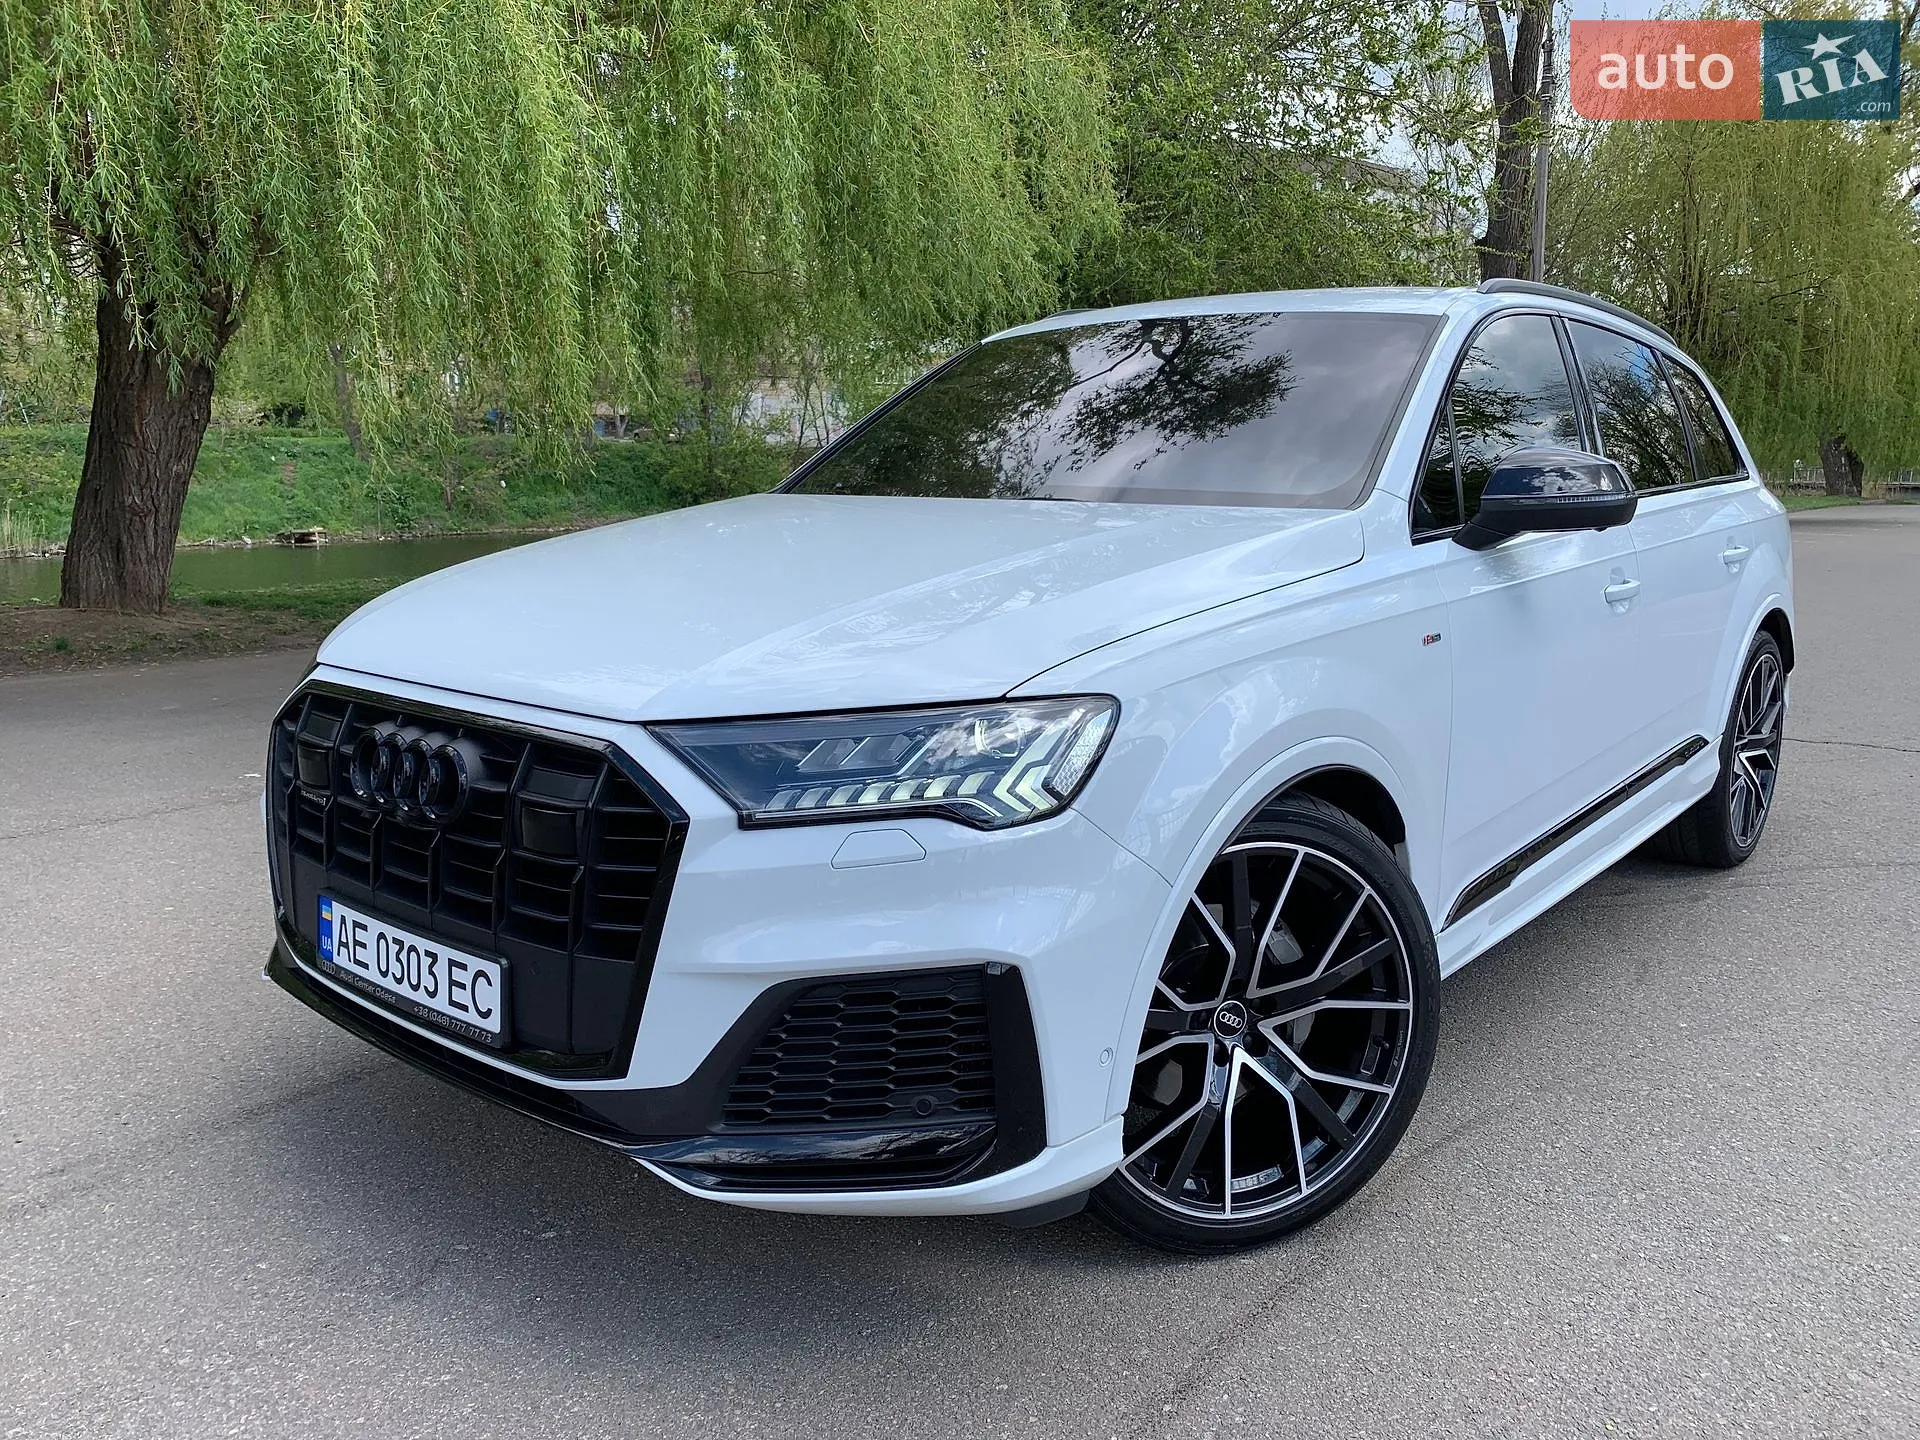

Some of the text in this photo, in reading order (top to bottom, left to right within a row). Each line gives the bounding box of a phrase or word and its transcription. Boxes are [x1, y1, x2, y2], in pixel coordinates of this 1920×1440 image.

[322, 936, 332, 952] UA
[337, 914, 493, 1019] AE 0303 EC
[414, 1006, 492, 1043] +38 (048) 777 77 73
